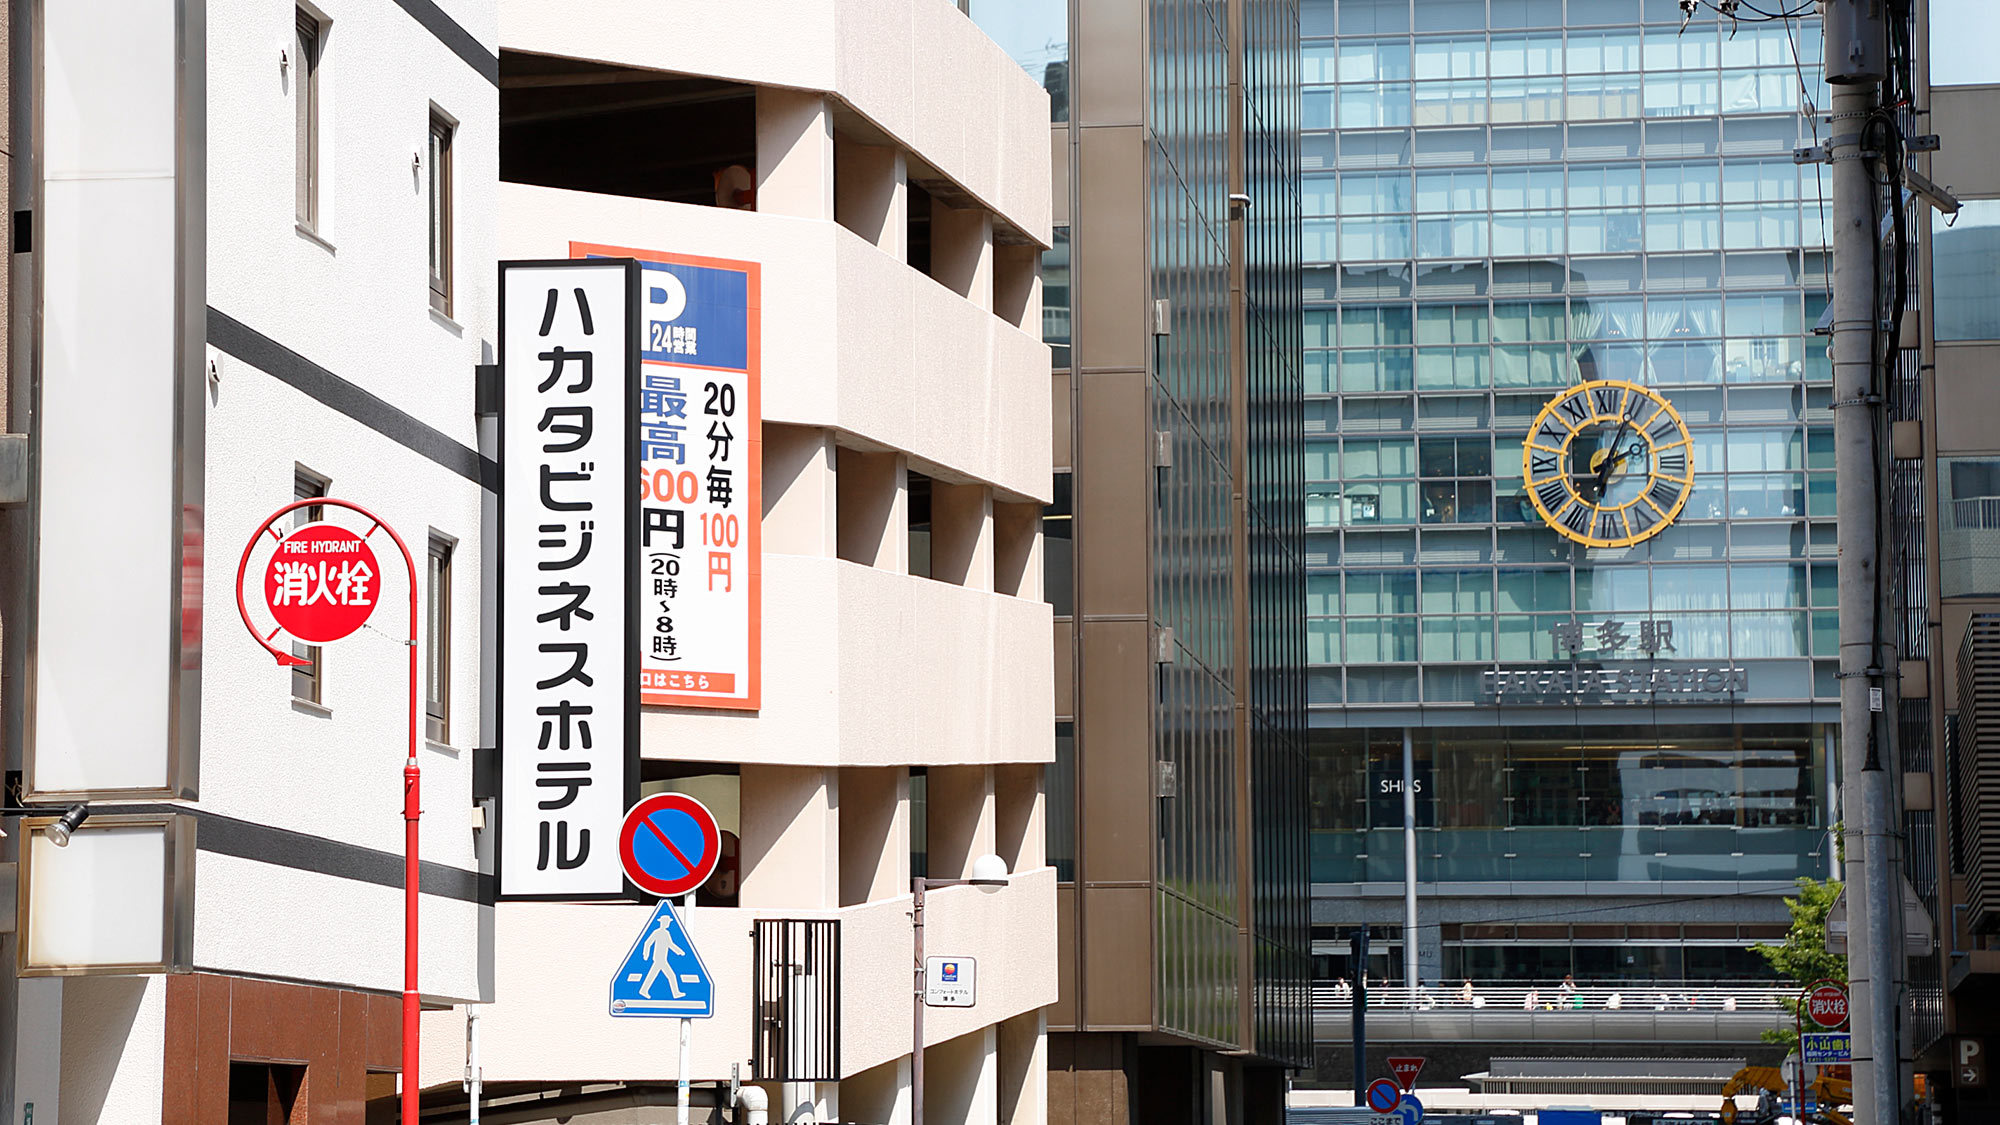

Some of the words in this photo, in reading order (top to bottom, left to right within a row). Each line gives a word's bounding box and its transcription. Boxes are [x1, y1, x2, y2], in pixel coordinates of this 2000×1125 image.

[641, 268, 687, 351] P
[284, 541, 308, 553] FIRE
[311, 540, 361, 553] HYDRANT
[273, 560, 374, 606] 消火栓
[536, 287, 595, 871] ハカタビジネスホテル
[1548, 619, 1677, 654] 博多駅
[1480, 669, 1605, 694] HAKATA
[1617, 668, 1748, 693] STATION
[1380, 779, 1422, 793] SHIS
[1812, 999, 1846, 1015] 消火栓
[1960, 1040, 1979, 1064] P
[1396, 1064, 1418, 1072] 止まれ
